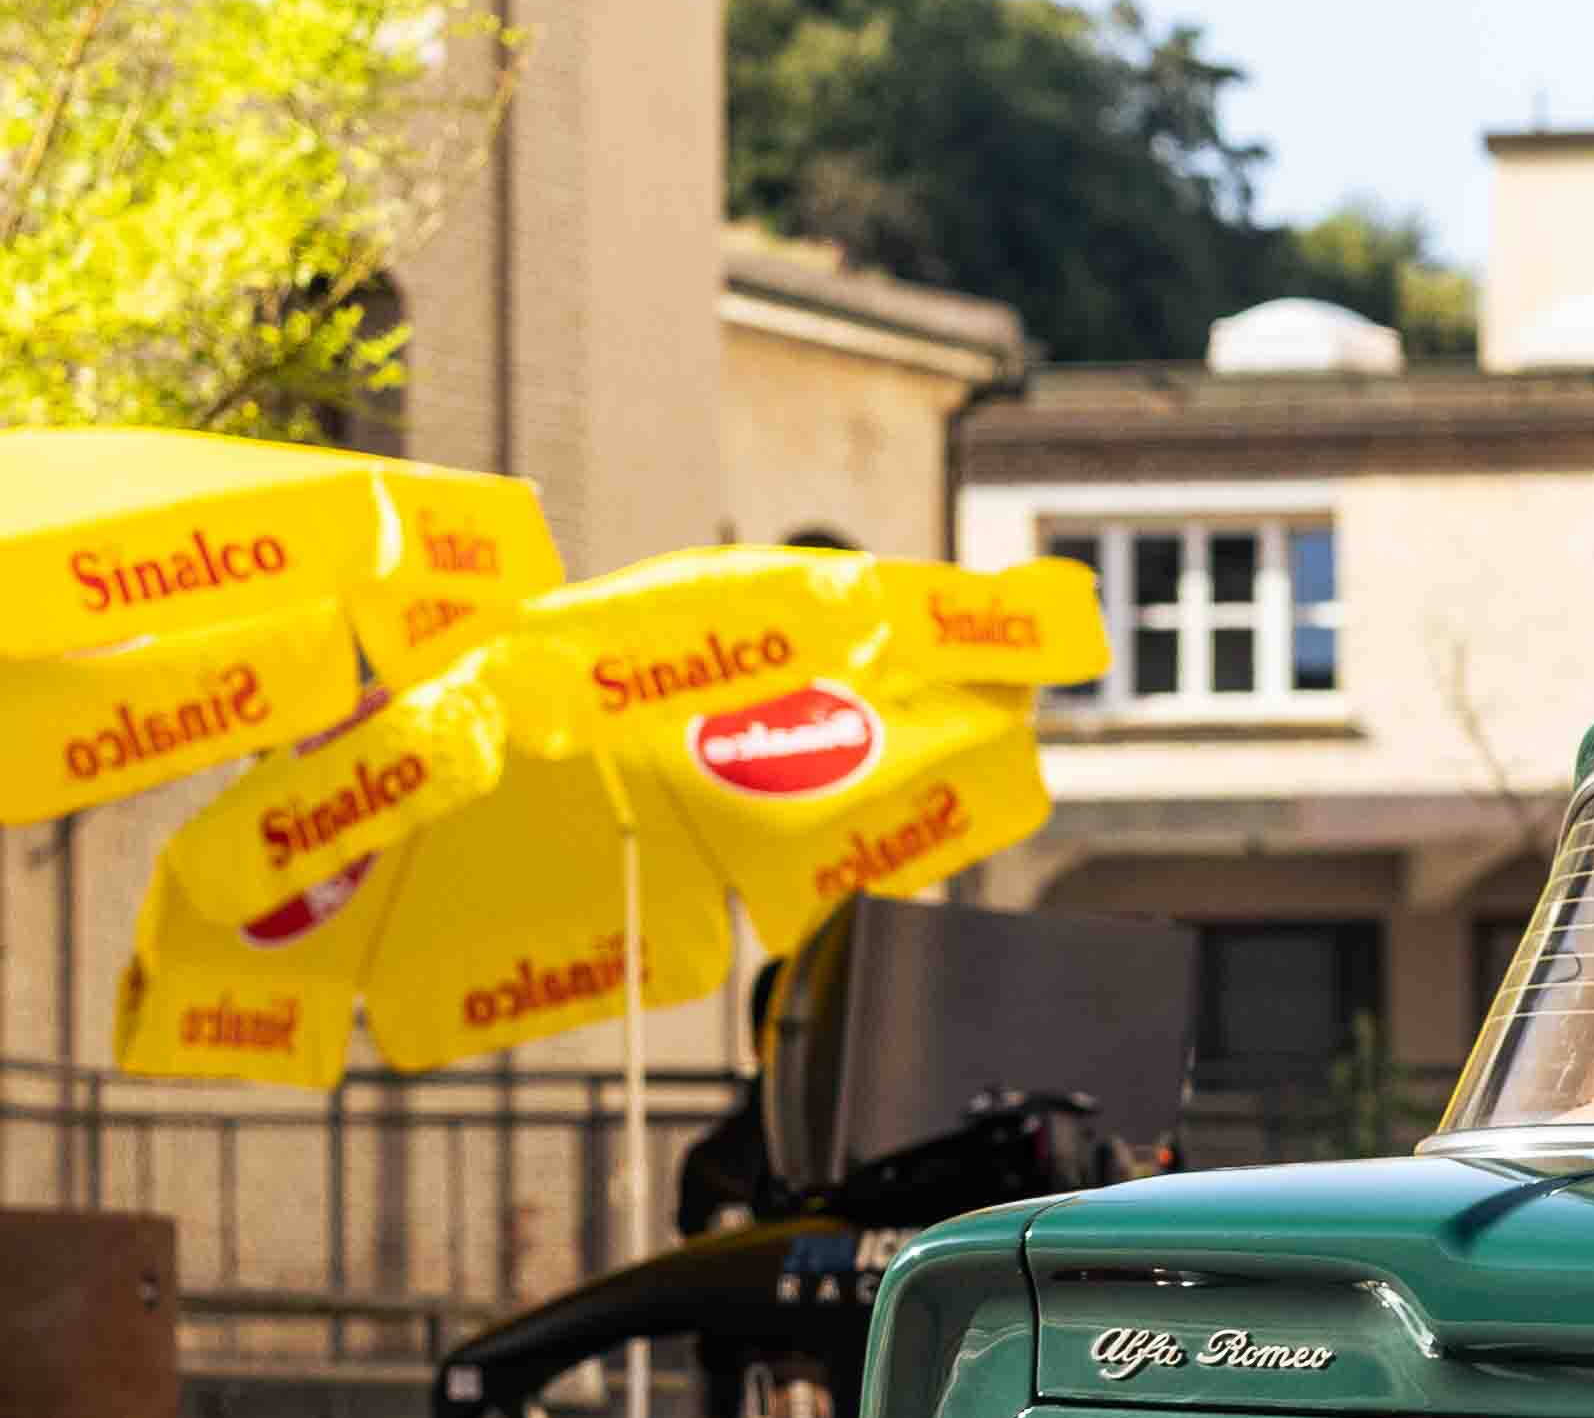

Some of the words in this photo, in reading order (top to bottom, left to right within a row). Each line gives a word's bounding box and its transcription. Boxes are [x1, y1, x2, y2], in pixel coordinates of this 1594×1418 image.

[70, 530, 286, 613] Sinalco
[592, 625, 795, 713] Sinalco
[260, 752, 428, 870] Sinalco
[1090, 1328, 1184, 1379] Alfa
[1196, 1329, 1332, 1369] Romeo
